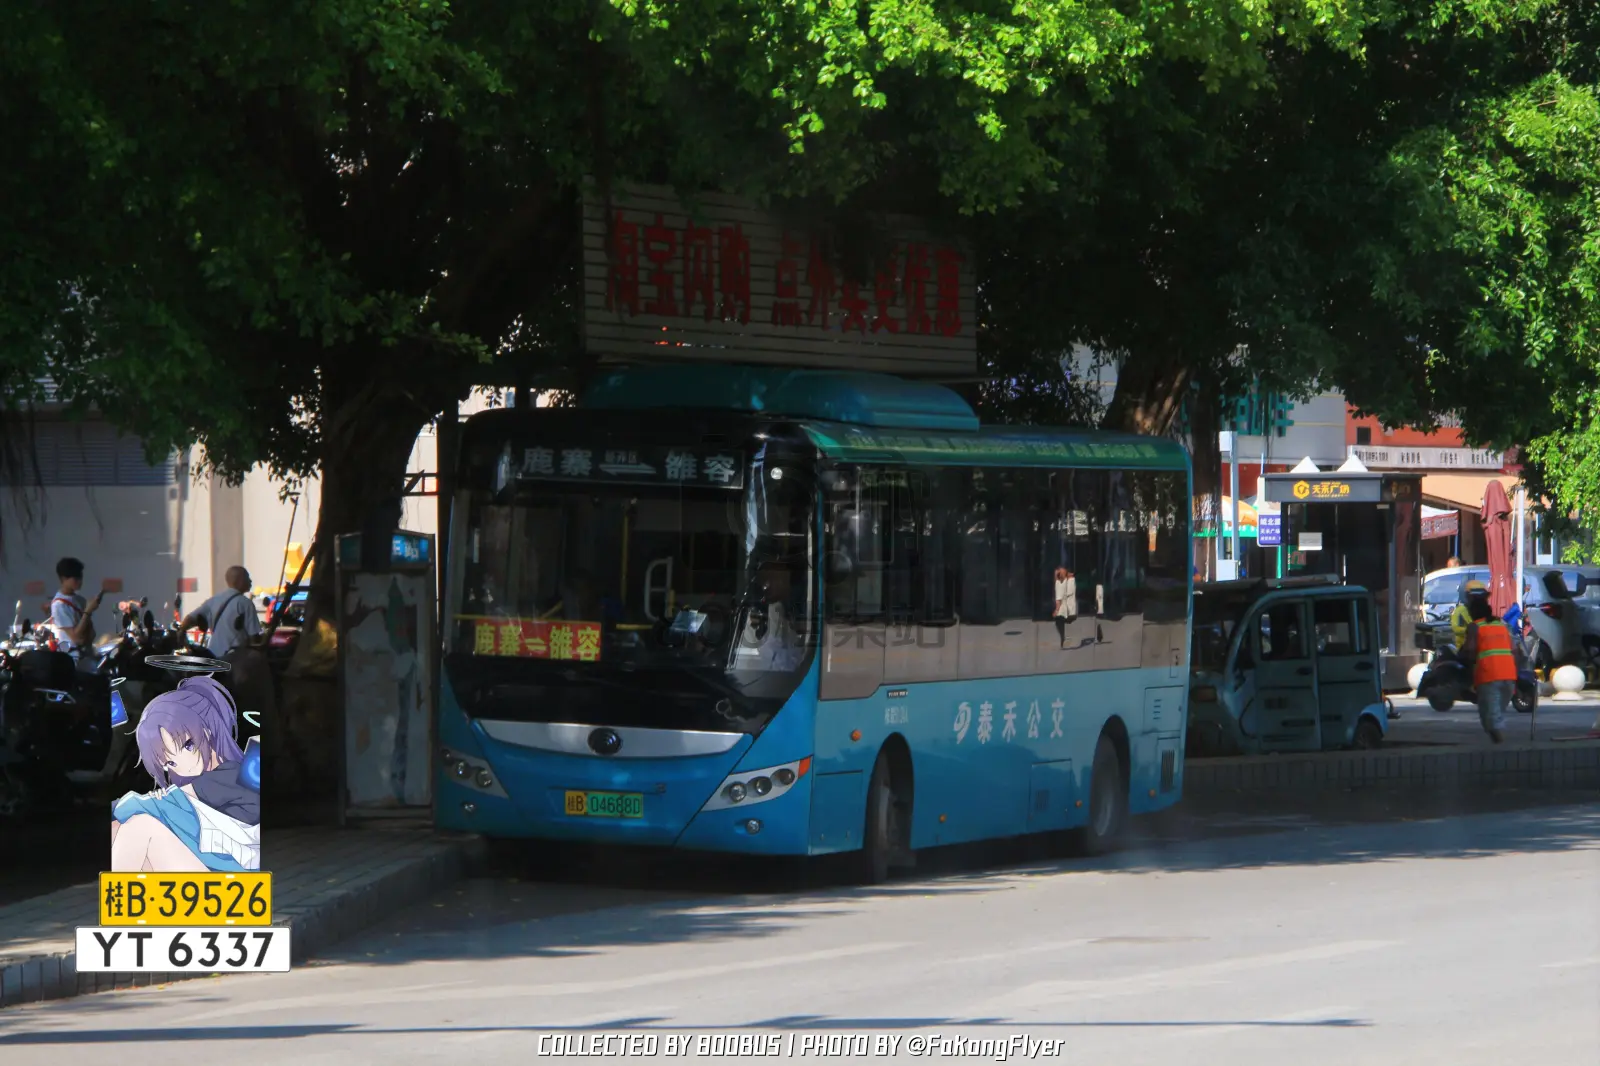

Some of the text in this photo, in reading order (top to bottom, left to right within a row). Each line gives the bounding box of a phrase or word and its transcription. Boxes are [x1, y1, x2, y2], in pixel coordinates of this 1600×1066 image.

[522, 445, 593, 477] 鹿寨
[1311, 483, 1350, 494] 天禾广场
[475, 623, 521, 656] 鹿寨
[977, 698, 1066, 744] 泰禾公交
